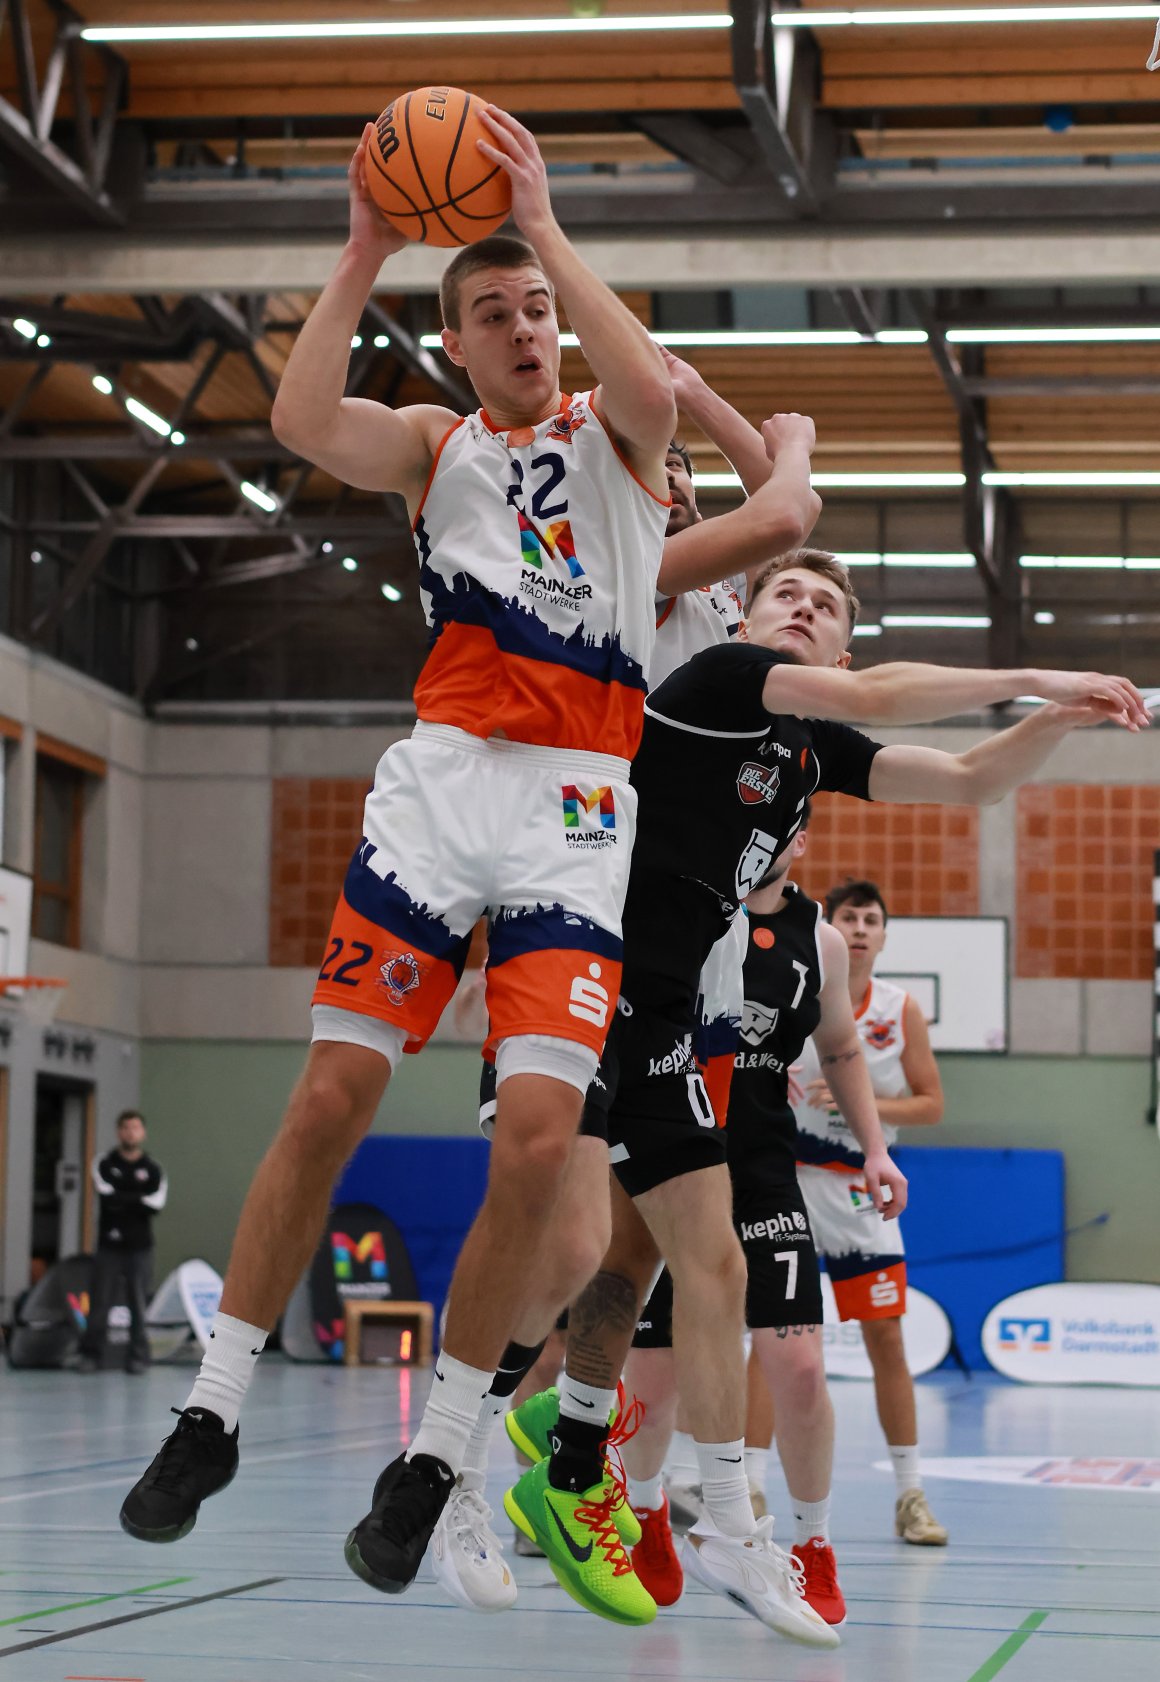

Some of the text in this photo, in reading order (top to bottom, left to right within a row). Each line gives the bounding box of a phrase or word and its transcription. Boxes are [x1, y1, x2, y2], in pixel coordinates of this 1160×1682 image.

[518, 581, 582, 612] STADTWERKE
[520, 568, 593, 599] MAINZER
[739, 774, 775, 801] ERSTE
[743, 767, 763, 780] DIE
[318, 937, 373, 987] 22
[790, 959, 810, 1010] 7
[685, 1073, 716, 1129] 0
[774, 1250, 798, 1300] 7
